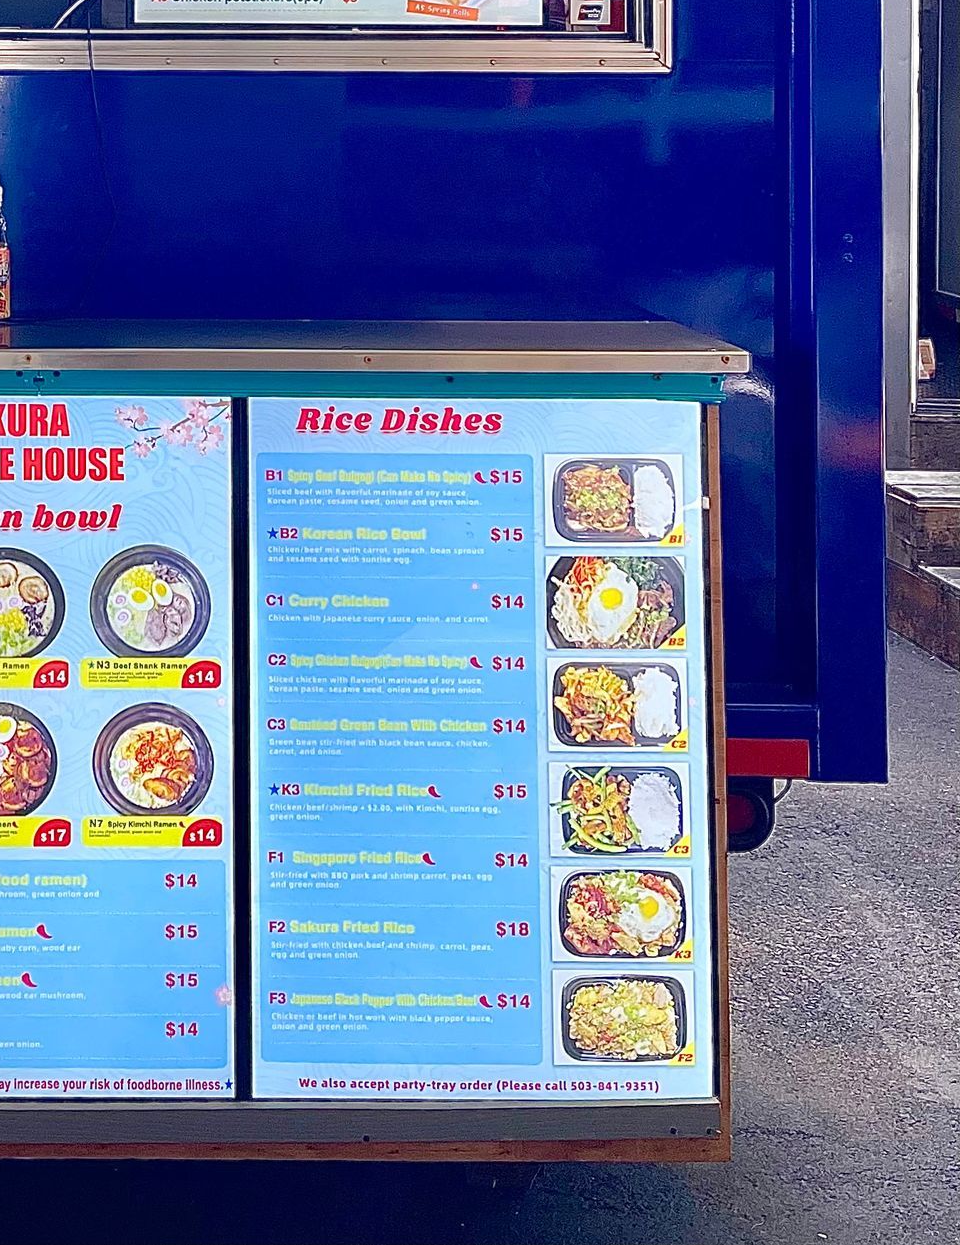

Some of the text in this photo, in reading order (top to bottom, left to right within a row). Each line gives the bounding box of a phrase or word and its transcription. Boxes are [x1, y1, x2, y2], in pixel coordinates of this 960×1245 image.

[296, 407, 503, 433] Rice Dishes
[23, 448, 125, 480] HOUSE
[265, 470, 522, 485] B1 $15
[32, 504, 122, 530] bowl
[280, 528, 523, 542] B2 $15
[266, 594, 524, 609] C1 $14
[40, 829, 65, 842] $17
[269, 922, 285, 933] F2
[496, 922, 529, 937] $18
[166, 1022, 198, 1037] $14
[14, 1079, 59, 1091] increase
[62, 1081, 86, 1093] your
[90, 1079, 110, 1091] risk
[113, 1079, 124, 1091] of
[127, 1079, 182, 1091] foodborne
[186, 1079, 224, 1091] illness.
[299, 1078, 659, 1093] We also accept party-tray order (Please call 503-841-9351)
